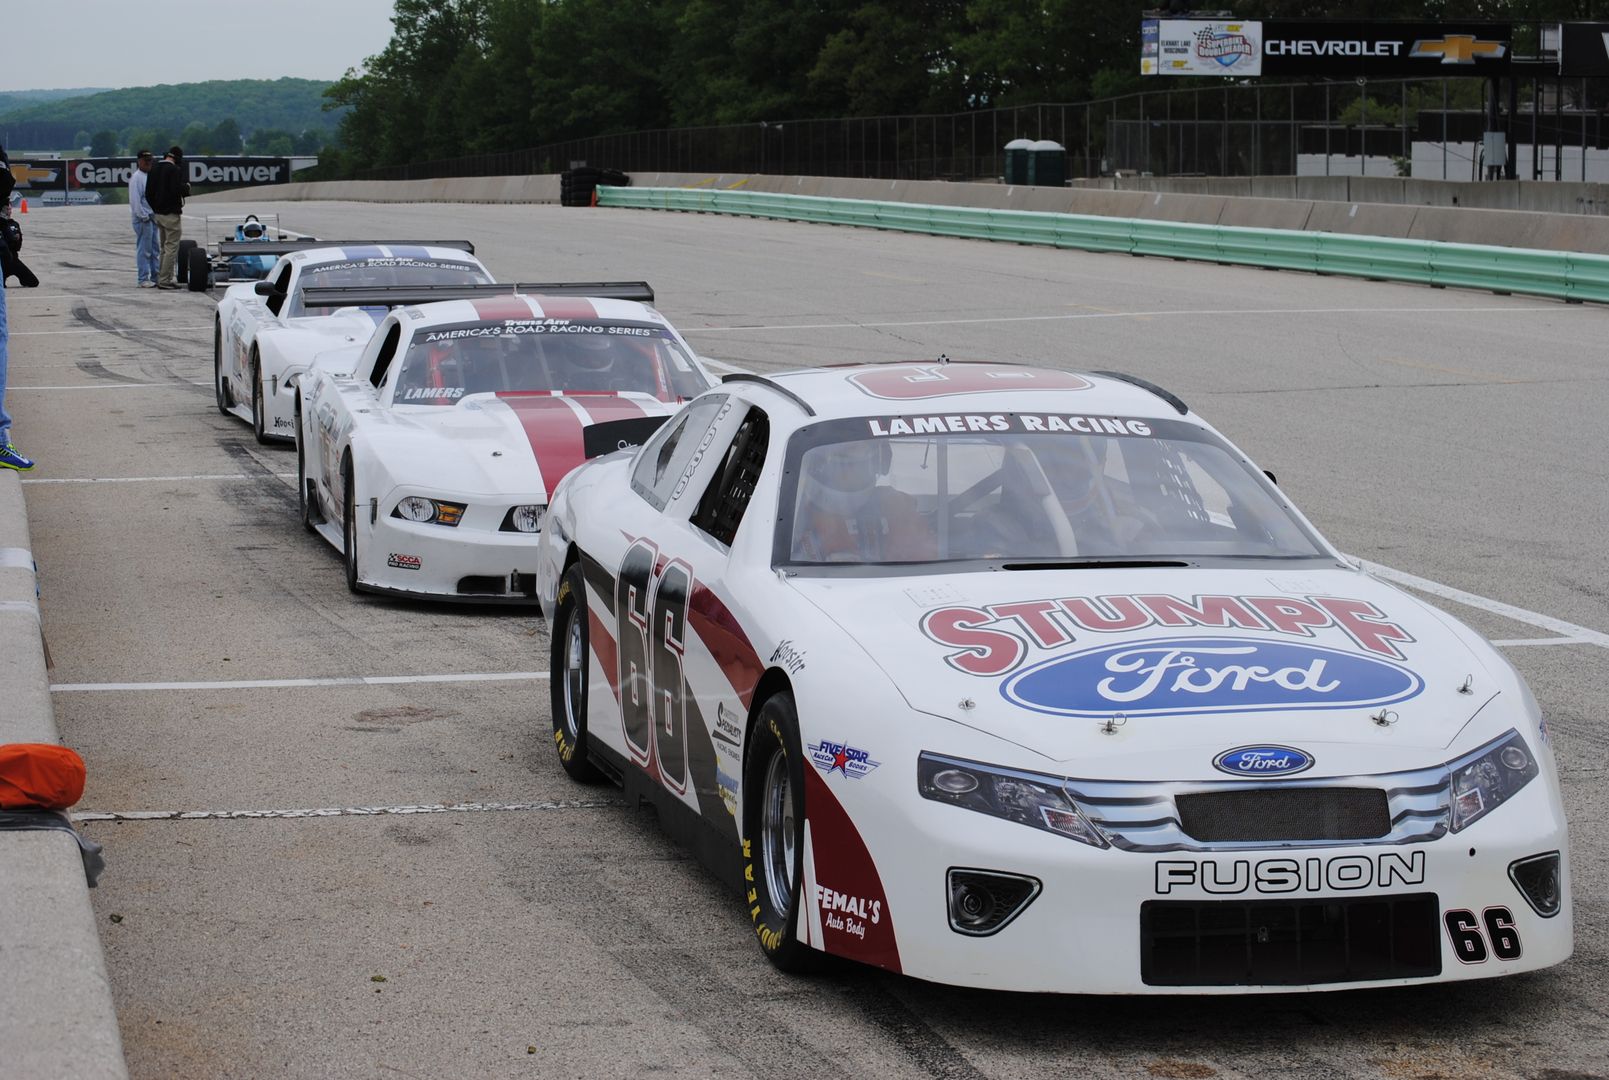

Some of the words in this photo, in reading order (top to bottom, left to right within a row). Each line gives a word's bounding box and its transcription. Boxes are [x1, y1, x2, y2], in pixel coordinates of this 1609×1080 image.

[1265, 40, 1403, 56] CHEVROLET
[189, 162, 280, 183] Denver
[313, 262, 366, 273] AMERICA'S
[440, 263, 471, 272] SERIES
[544, 318, 571, 326] Am
[425, 327, 501, 342] AMERICA'S
[505, 325, 546, 334] ROAD
[549, 325, 604, 334] RACING
[608, 326, 651, 337] SERIES
[404, 387, 465, 400] LAMERS
[868, 415, 1010, 437] LAMERS
[1018, 415, 1152, 437] RACING
[397, 554, 420, 564] SCCA
[919, 594, 1418, 677] STUMPF
[614, 537, 693, 795] 66
[770, 639, 807, 675] Hoosier
[1096, 646, 1342, 702] Ford
[820, 741, 843, 755] FIVE
[846, 748, 869, 764] STAR
[1237, 752, 1291, 771] Ford
[1155, 850, 1426, 895] FUSION
[814, 883, 881, 924] FEMAL'S
[825, 912, 844, 931] Auto
[846, 917, 866, 940] Body
[1442, 904, 1523, 965] 66
